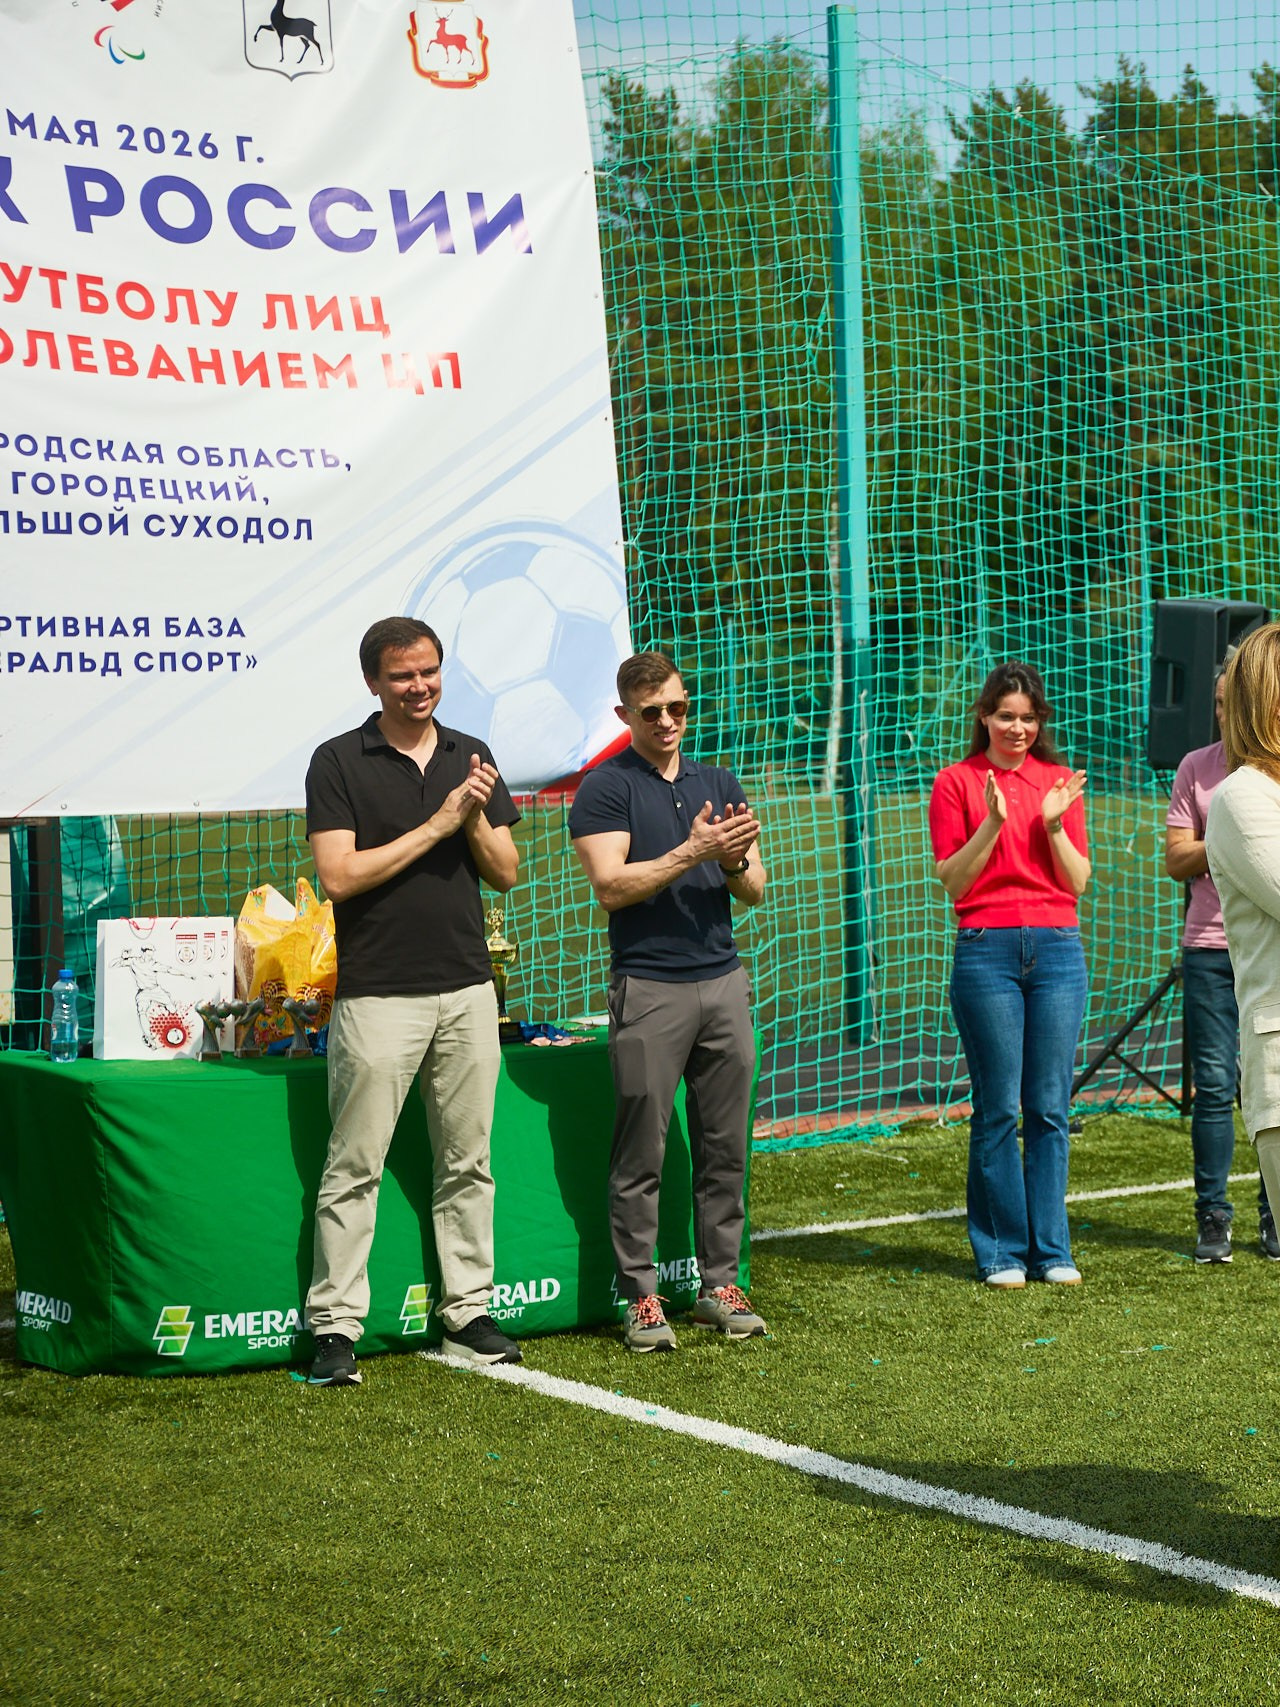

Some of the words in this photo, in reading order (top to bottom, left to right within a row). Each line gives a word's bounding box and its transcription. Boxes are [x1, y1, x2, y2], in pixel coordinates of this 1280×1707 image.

[6, 108, 99, 147] МАЯ
[116, 124, 219, 159] 2026
[236, 135, 265, 163] Г.
[64, 164, 533, 254] РОССИИ
[0, 261, 239, 327] УТБОЛУ
[262, 293, 391, 339] ЛИЦ
[381, 351, 462, 396] ЦП
[177, 445, 352, 472] ОБЛАСТЬ,
[11, 471, 270, 505] ГОРОДЕЦКИЙ,
[143, 514, 313, 544] СУХОДОЛ
[164, 617, 246, 638] БАЗА
[0, 651, 122, 677] РАЛЬД
[133, 651, 259, 673] СПОРТ»
[487, 1277, 561, 1309] RALD
[674, 1278, 702, 1293] SPOR
[22, 1315, 53, 1332] SPORT
[204, 1308, 310, 1339] EMERA
[488, 1306, 526, 1320] PORT
[247, 1334, 299, 1350] SPORT
